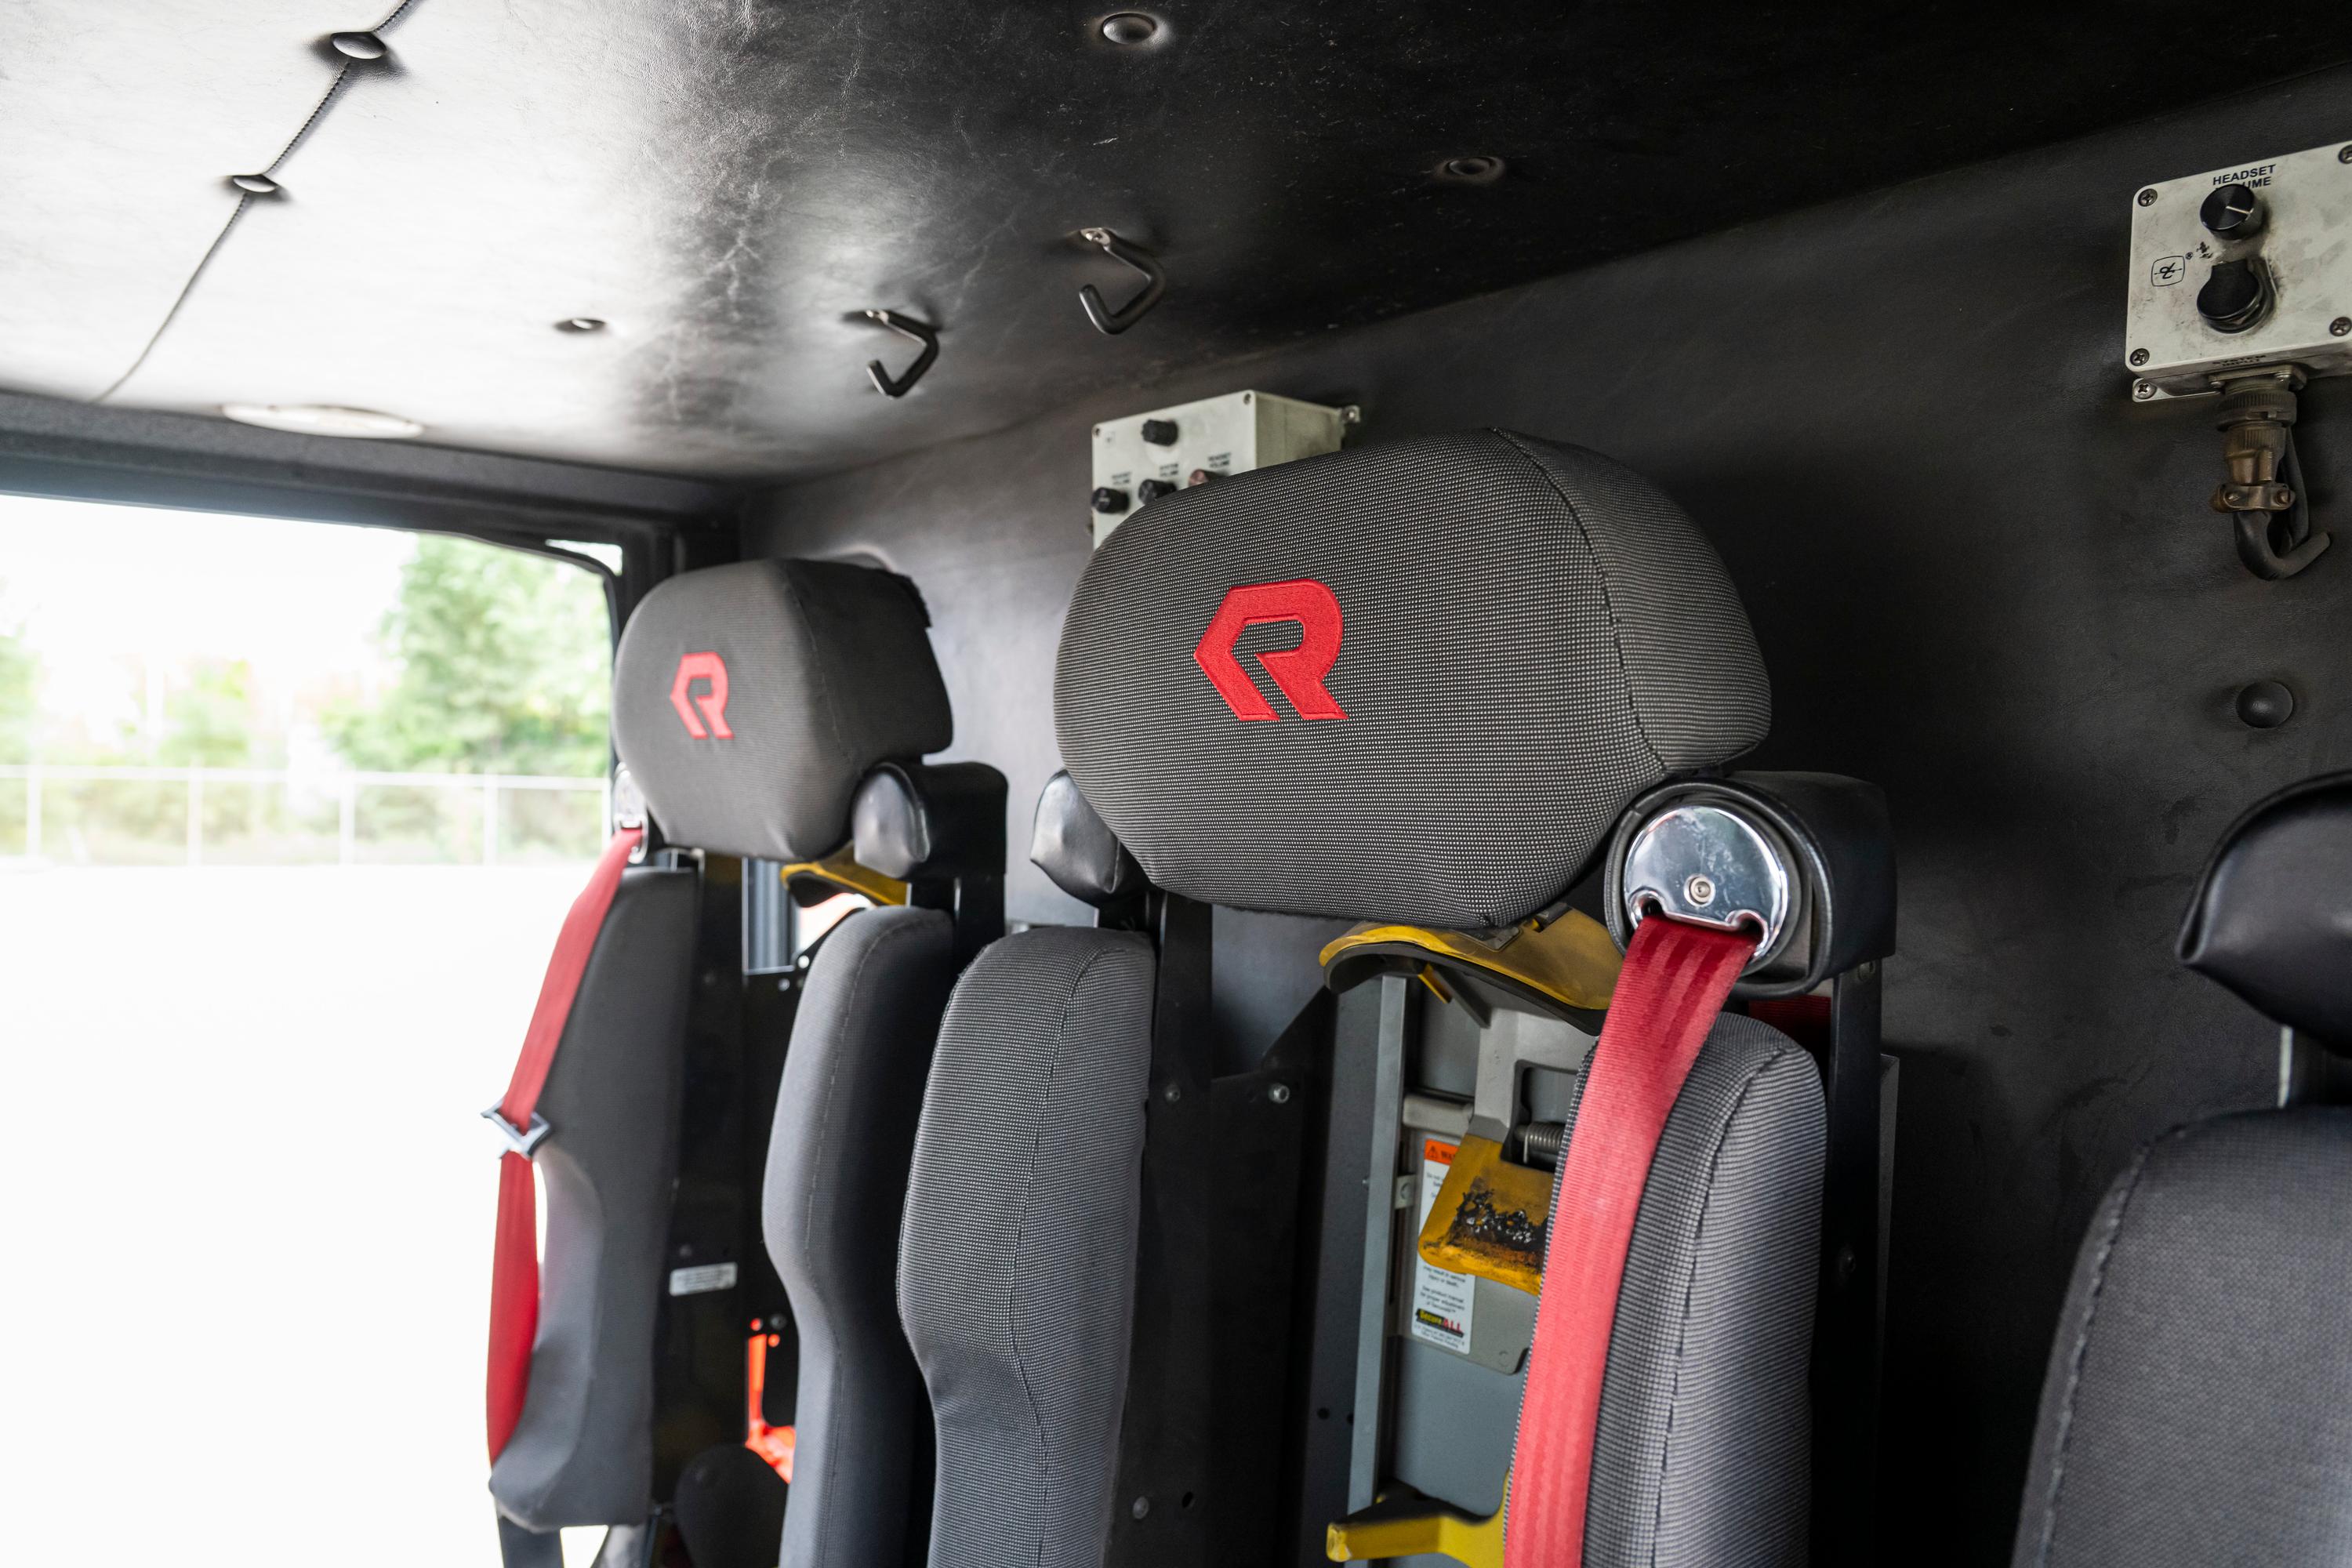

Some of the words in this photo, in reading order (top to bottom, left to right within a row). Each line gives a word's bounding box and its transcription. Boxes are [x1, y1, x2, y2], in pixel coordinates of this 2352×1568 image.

[2213, 164, 2276, 185] HEADSET
[1193, 579, 1348, 720] R
[670, 650, 735, 739] R
